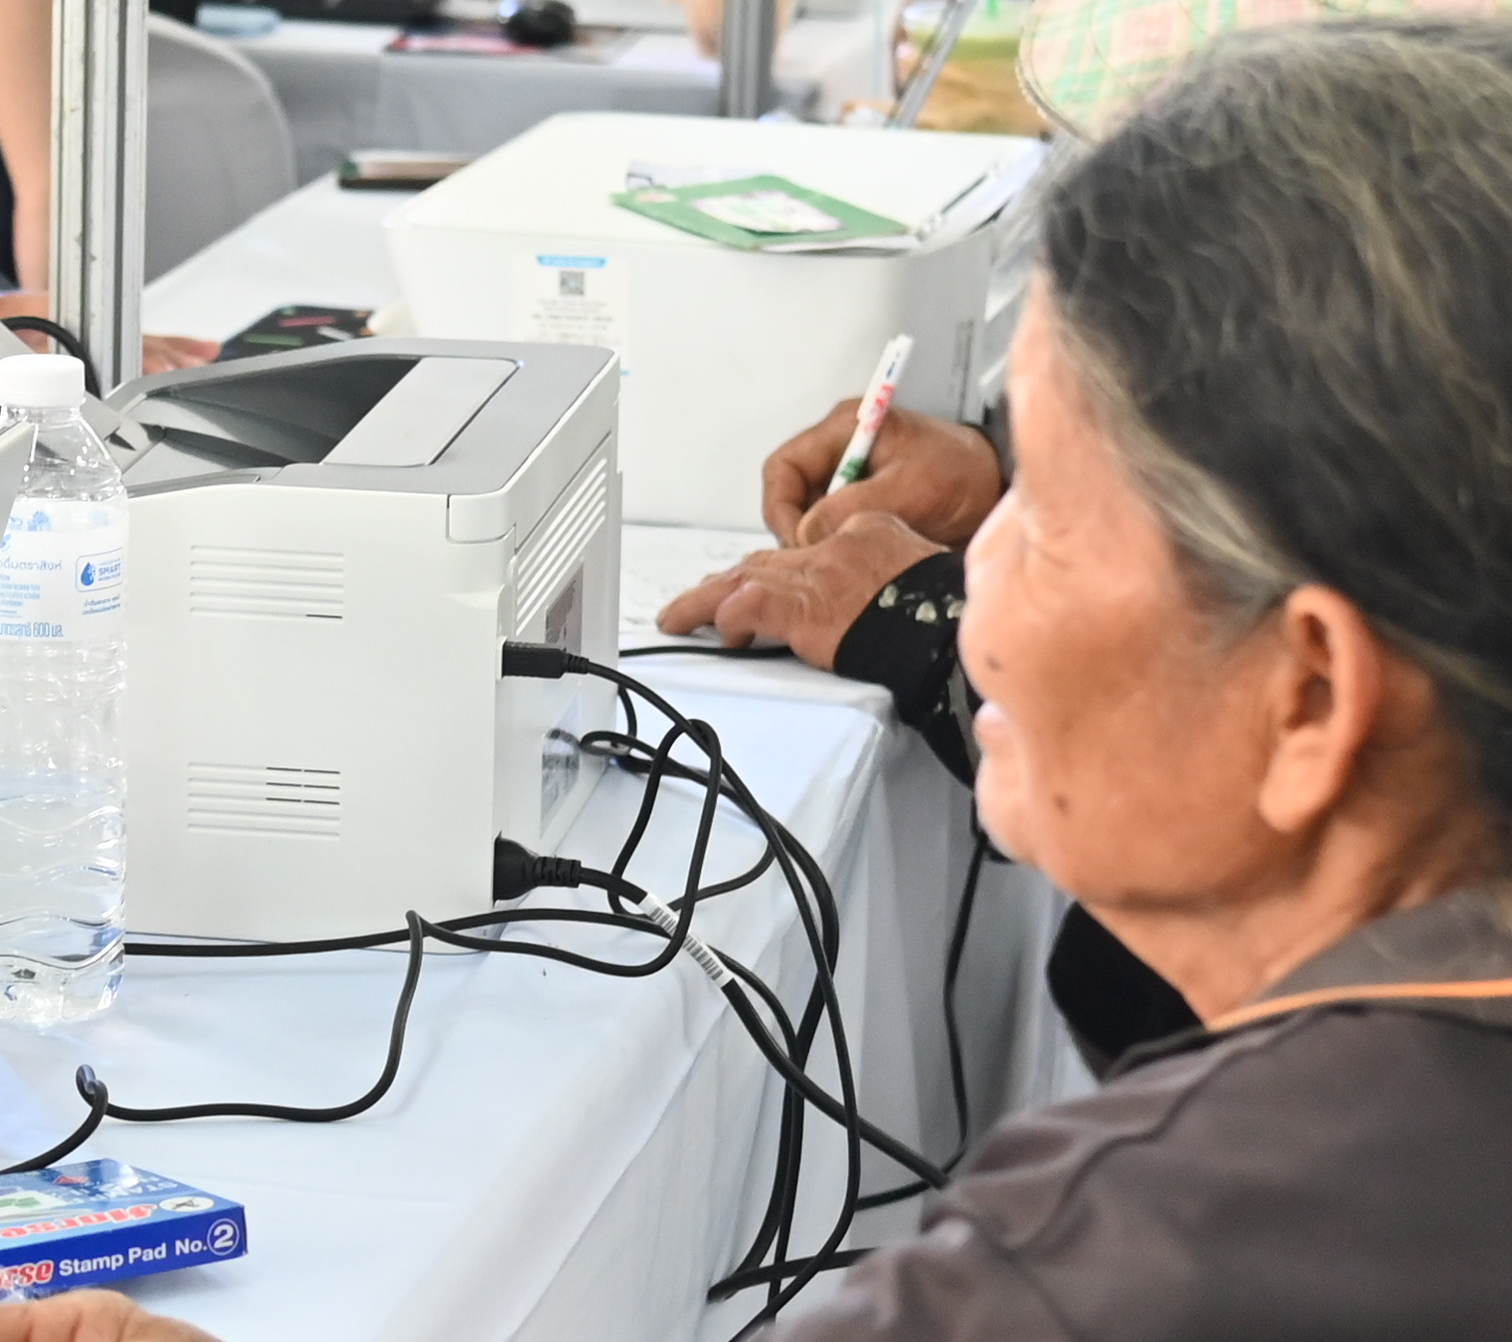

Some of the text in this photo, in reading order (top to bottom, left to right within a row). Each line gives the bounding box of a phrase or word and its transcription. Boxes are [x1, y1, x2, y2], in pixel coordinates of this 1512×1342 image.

[58, 1253, 124, 1277] Stamp
[128, 1243, 167, 1265] Pad
[175, 1236, 208, 1257] No.
[211, 1222, 236, 1251] 2
